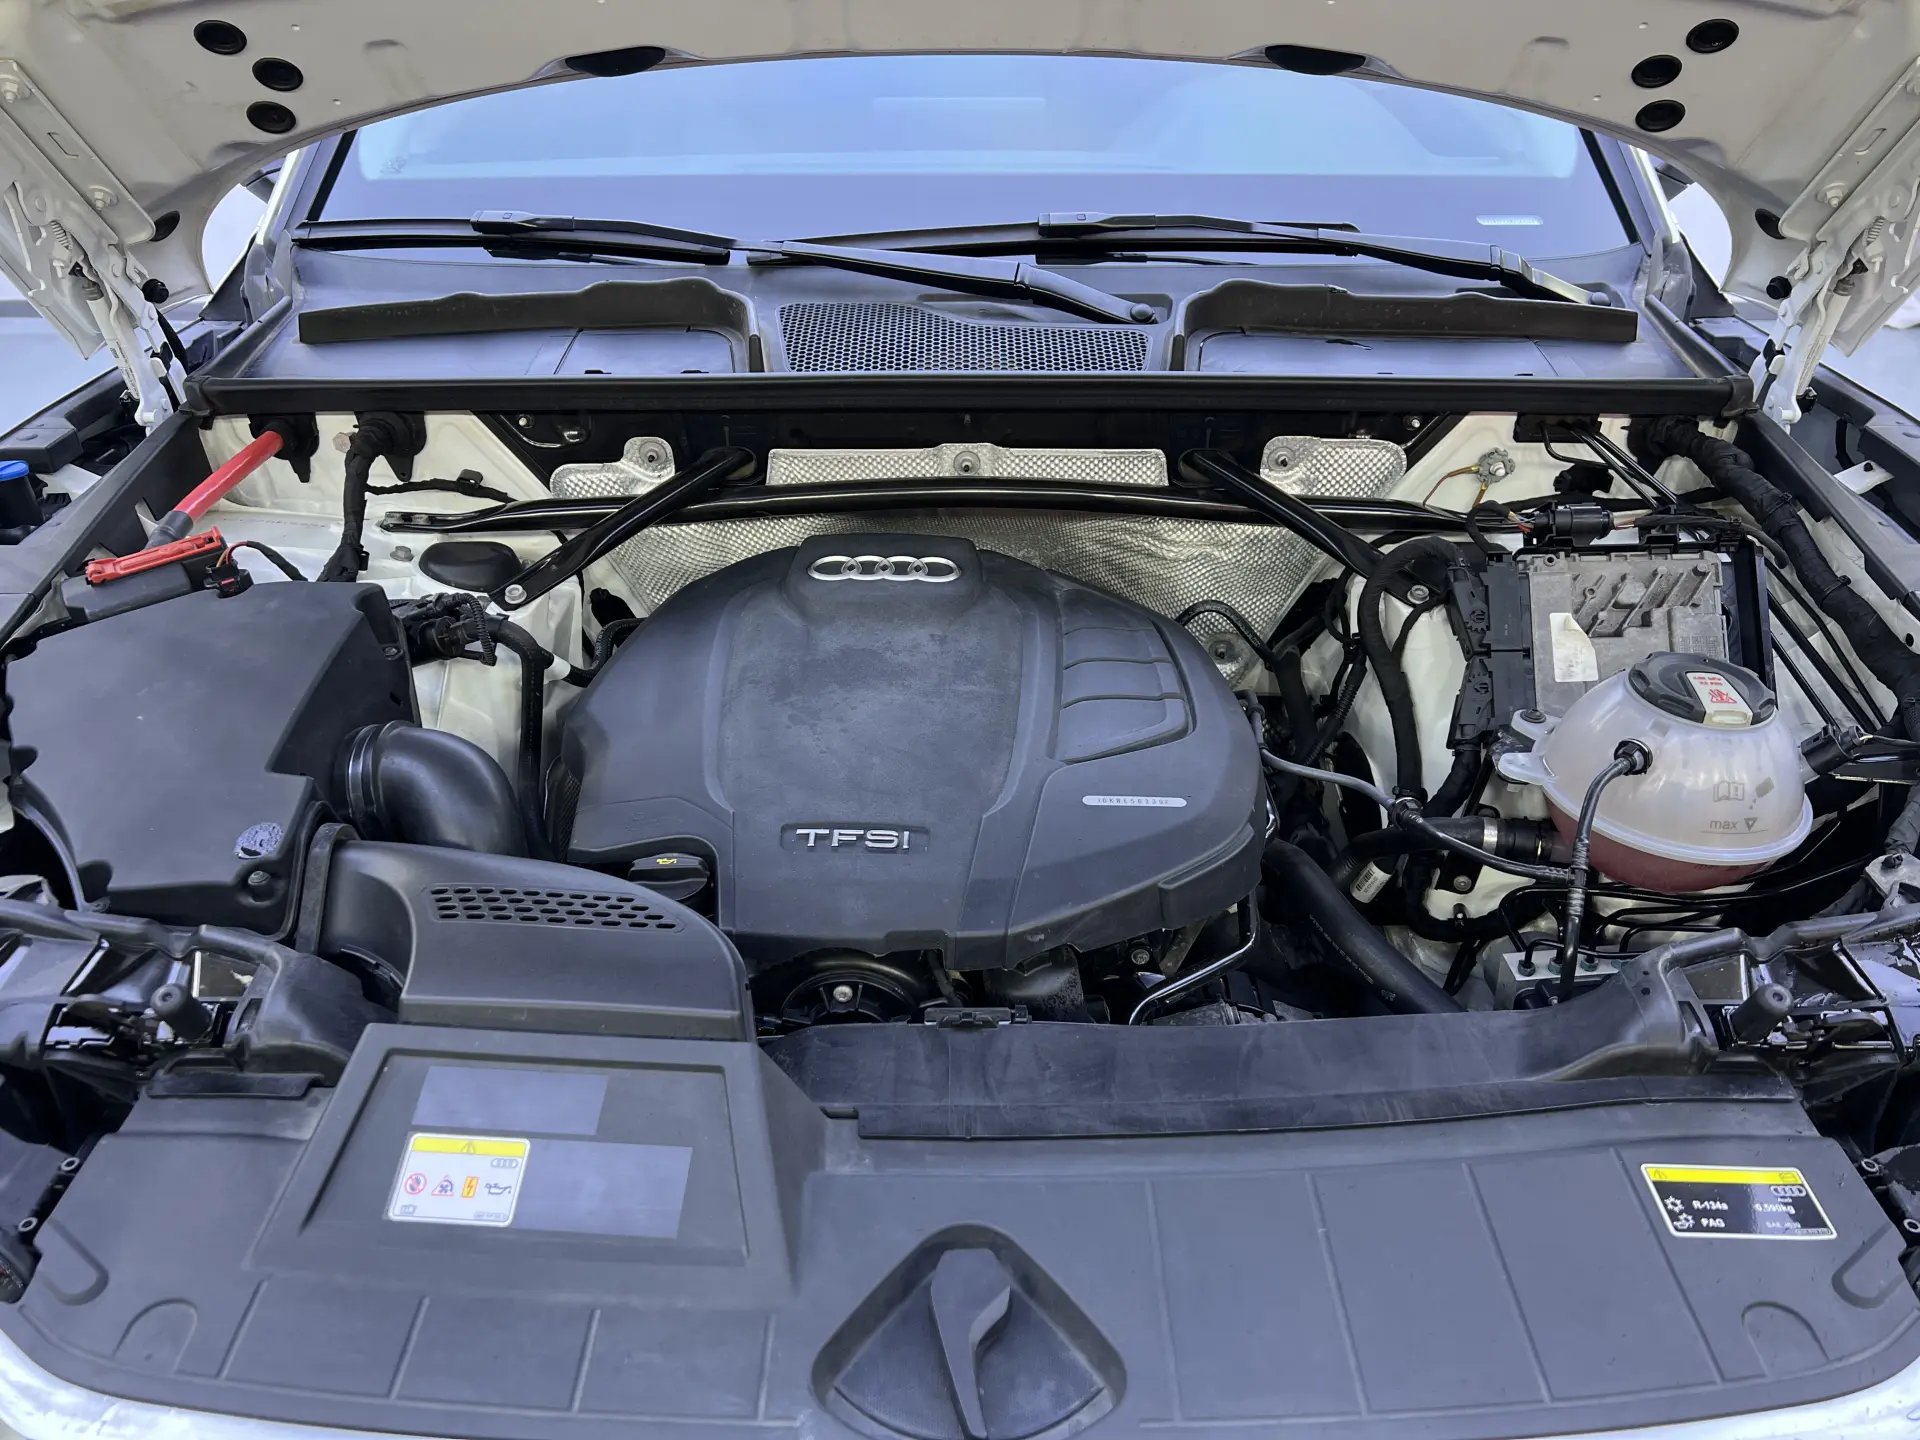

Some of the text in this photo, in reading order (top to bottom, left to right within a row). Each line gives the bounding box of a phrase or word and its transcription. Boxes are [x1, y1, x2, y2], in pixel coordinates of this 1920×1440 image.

[1709, 820, 1738, 830] max
[795, 828, 910, 849] TFSI
[1692, 1200, 1728, 1211] R-134a
[1700, 1217, 1725, 1228] PAG
